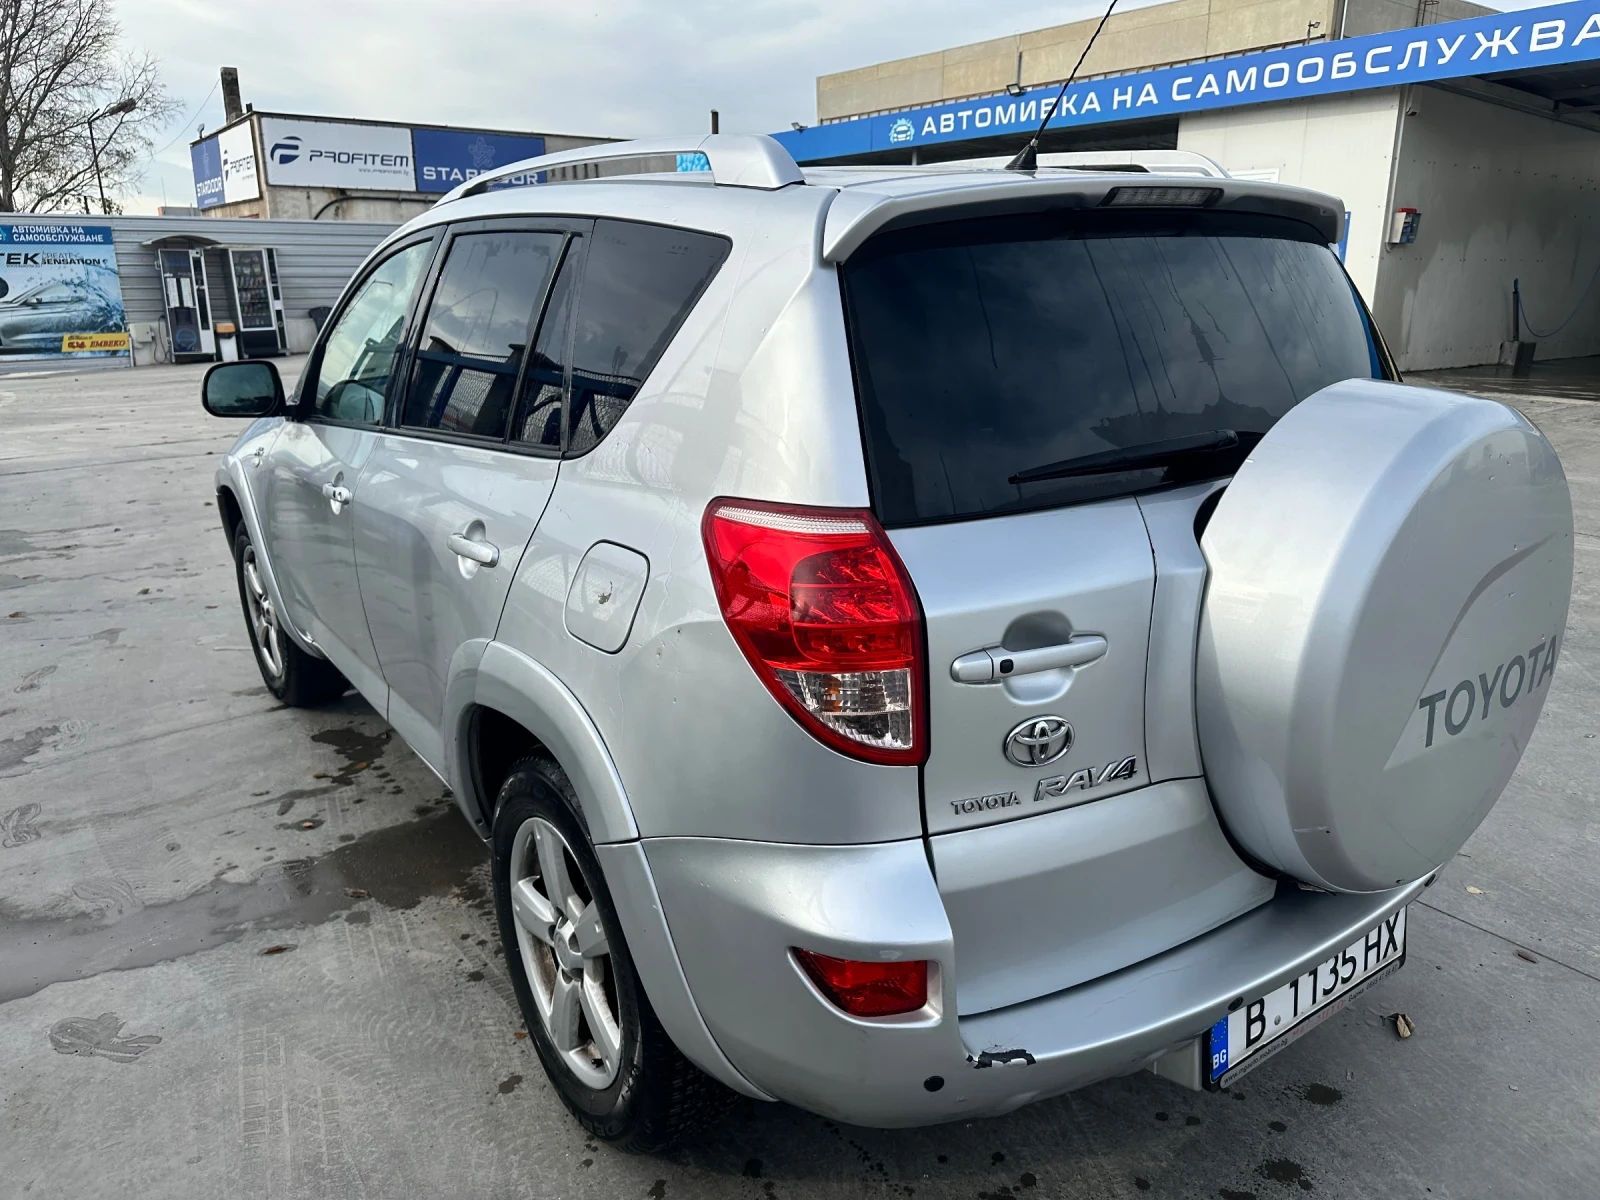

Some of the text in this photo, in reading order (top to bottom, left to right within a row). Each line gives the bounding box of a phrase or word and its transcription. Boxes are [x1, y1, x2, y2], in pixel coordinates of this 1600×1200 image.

[922, 92, 1100, 135] АВТОМИВКА
[1113, 83, 1158, 110] НА
[309, 150, 409, 167] PROFITEM
[12, 225, 84, 234] АВТОМИВКА НА
[13, 234, 104, 242] САМООБСЛУЖВАНЕ
[1418, 635, 1557, 748] TOYOTA
[950, 755, 1137, 815] TOYOTA RAV4
[1246, 911, 1399, 1049] B 1135 HX
[1212, 1049, 1227, 1069] BG
